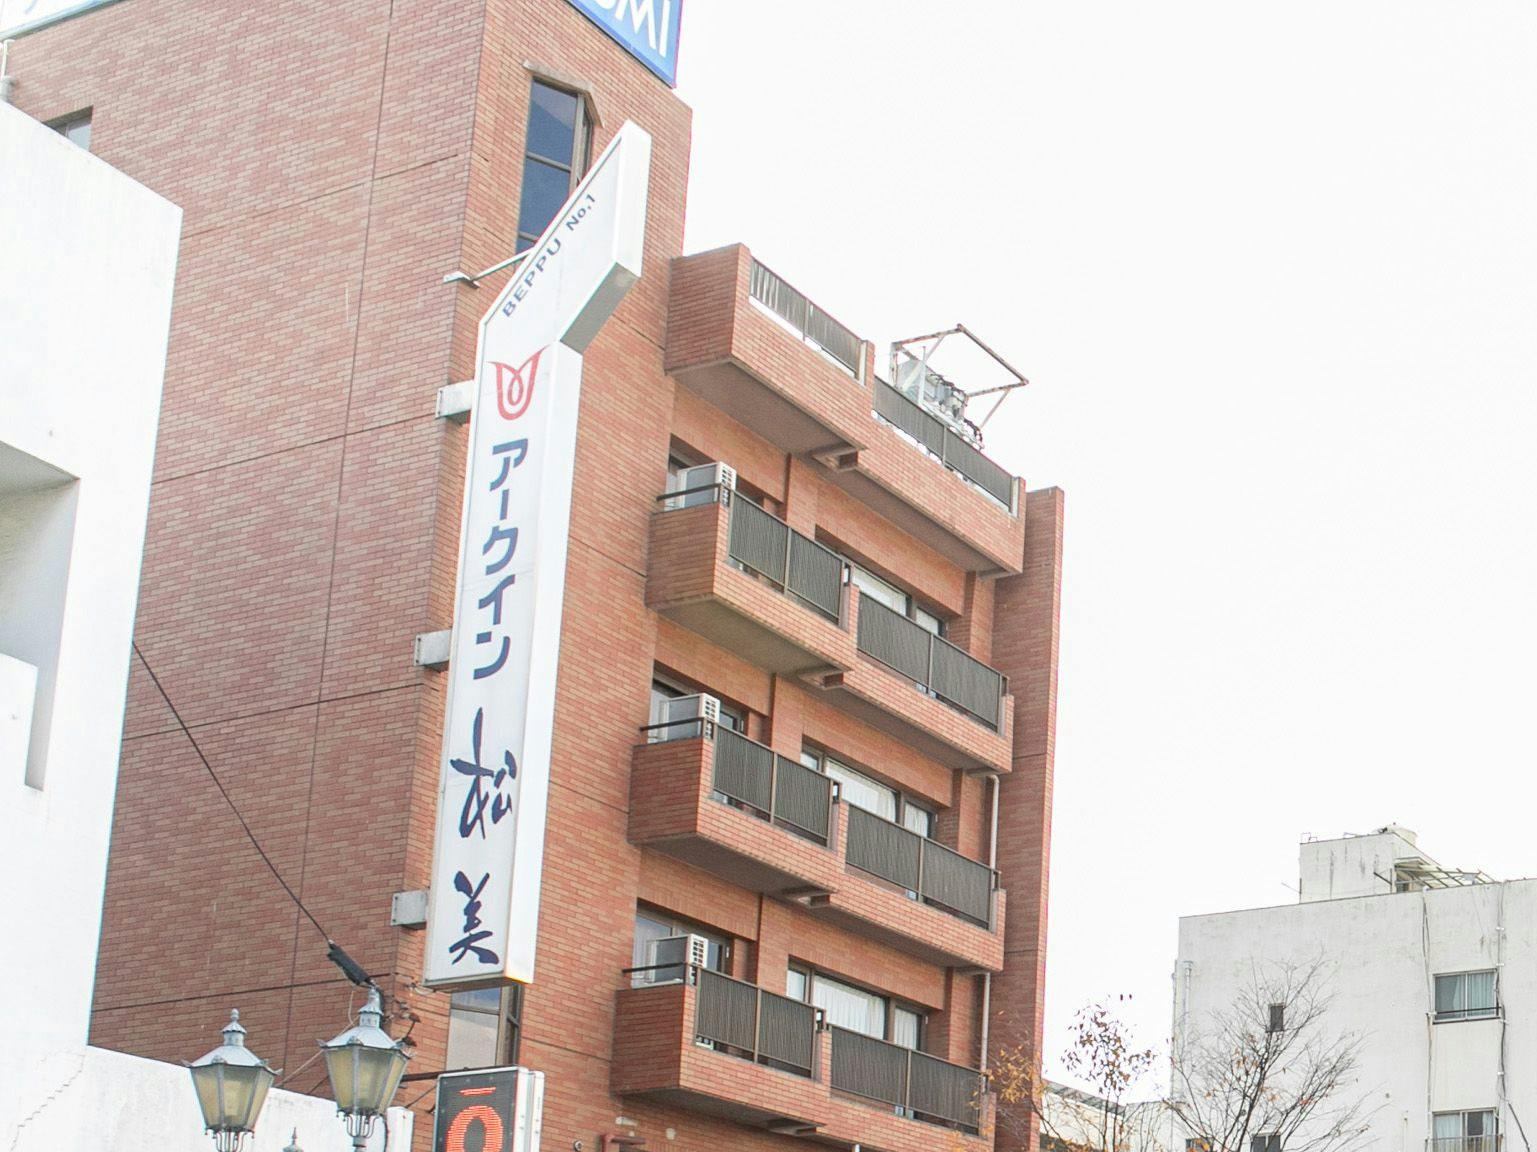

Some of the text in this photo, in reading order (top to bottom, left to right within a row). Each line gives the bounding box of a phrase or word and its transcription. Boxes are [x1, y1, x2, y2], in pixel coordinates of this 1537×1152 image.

[501, 193, 596, 317] BEPPU No.1
[448, 437, 529, 966] アークイン 松美
